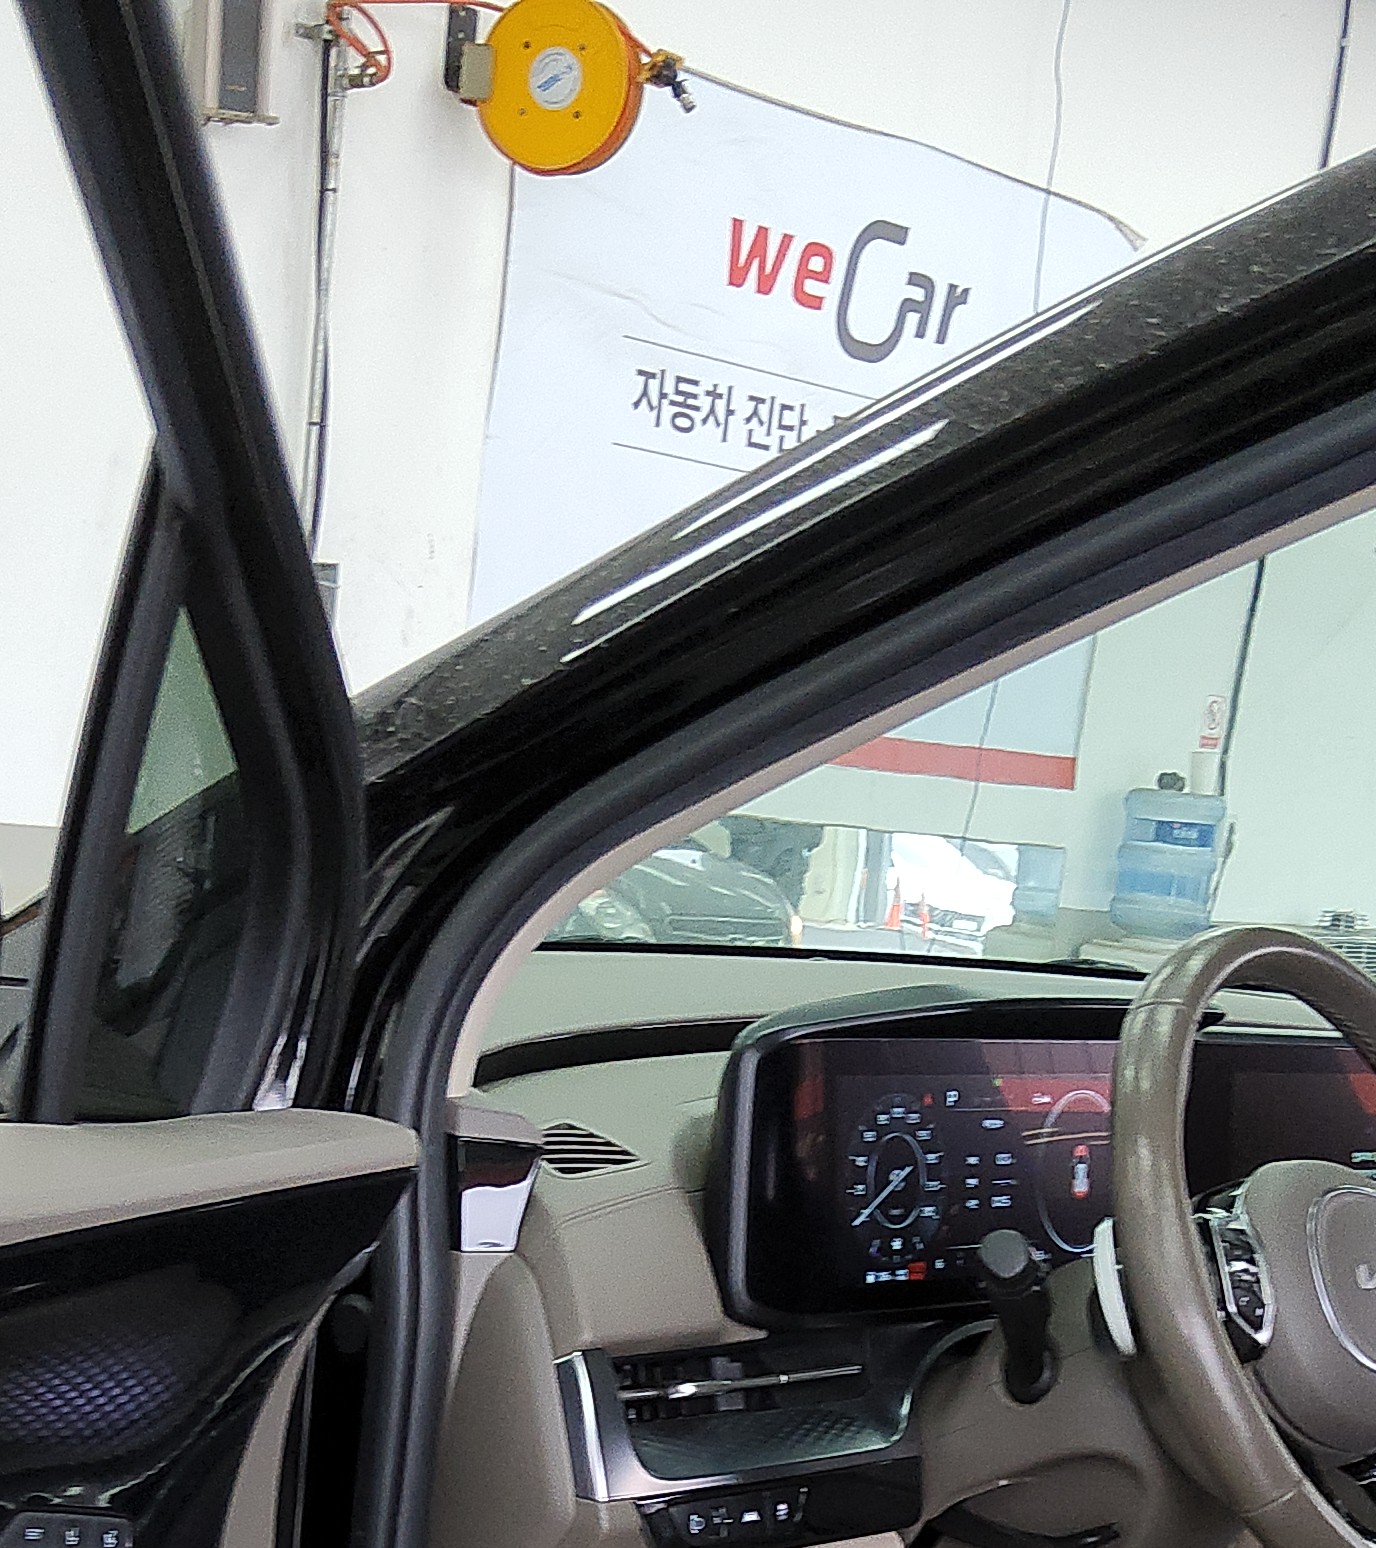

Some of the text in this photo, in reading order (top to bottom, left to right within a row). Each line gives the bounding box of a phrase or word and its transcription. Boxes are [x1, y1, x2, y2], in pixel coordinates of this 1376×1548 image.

[727, 217, 972, 364] weCar
[631, 368, 809, 453] 자동차 진단
